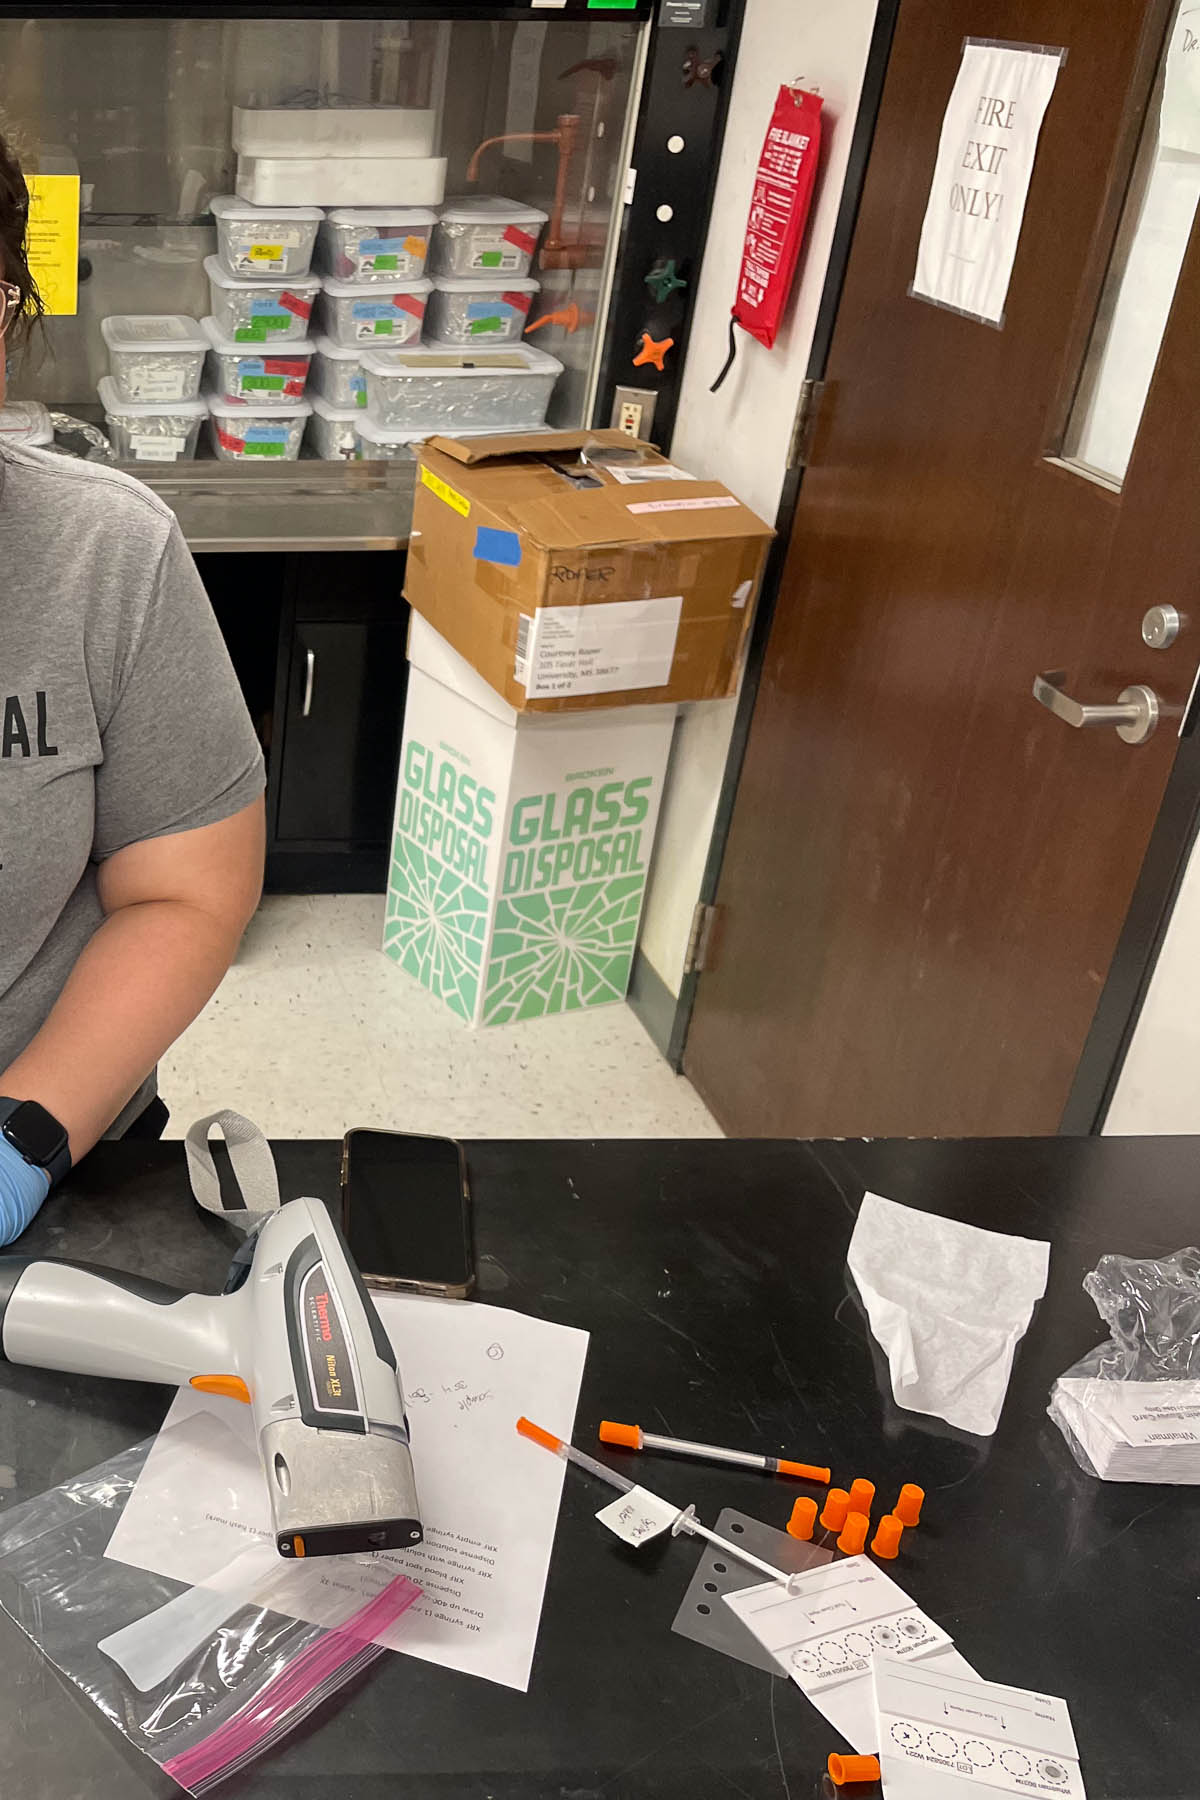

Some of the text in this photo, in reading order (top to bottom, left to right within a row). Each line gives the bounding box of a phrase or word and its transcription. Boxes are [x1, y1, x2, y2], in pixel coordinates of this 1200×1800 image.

[974, 96, 1017, 129] FIRE
[961, 140, 1009, 175] EXIT
[950, 183, 1005, 222] ONLY!
[536, 683, 550, 691] Box
[404, 740, 496, 838] GLASS
[509, 776, 653, 846] GLASS
[398, 788, 489, 893] DISPOSAL
[502, 829, 645, 895] DISPOSAL
[308, 1296, 322, 1343] SCIENTIFIC
[315, 1293, 332, 1342] Thermo
[326, 1354, 336, 1377] Niton
[1133, 1414, 1156, 1422] Card
[425, 1540, 495, 1566] solution Dispense
[455, 1534, 482, 1547] empty
[483, 1543, 499, 1553] XRF
[380, 1553, 404, 1566] paper
[404, 1562, 423, 1572] spot
[424, 1567, 447, 1579] blood
[449, 1575, 465, 1585] XRF
[427, 1553, 446, 1563] with
[447, 1560, 476, 1574] syringe
[476, 1569, 493, 1580] XRF
[413, 1578, 423, 1586] 20
[425, 1581, 462, 1598] Dispense
[435, 1613, 464, 1627] syringe
[465, 1622, 481, 1632] XRF
[449, 1603, 461, 1613] up
[462, 1607, 484, 1619] Draw
